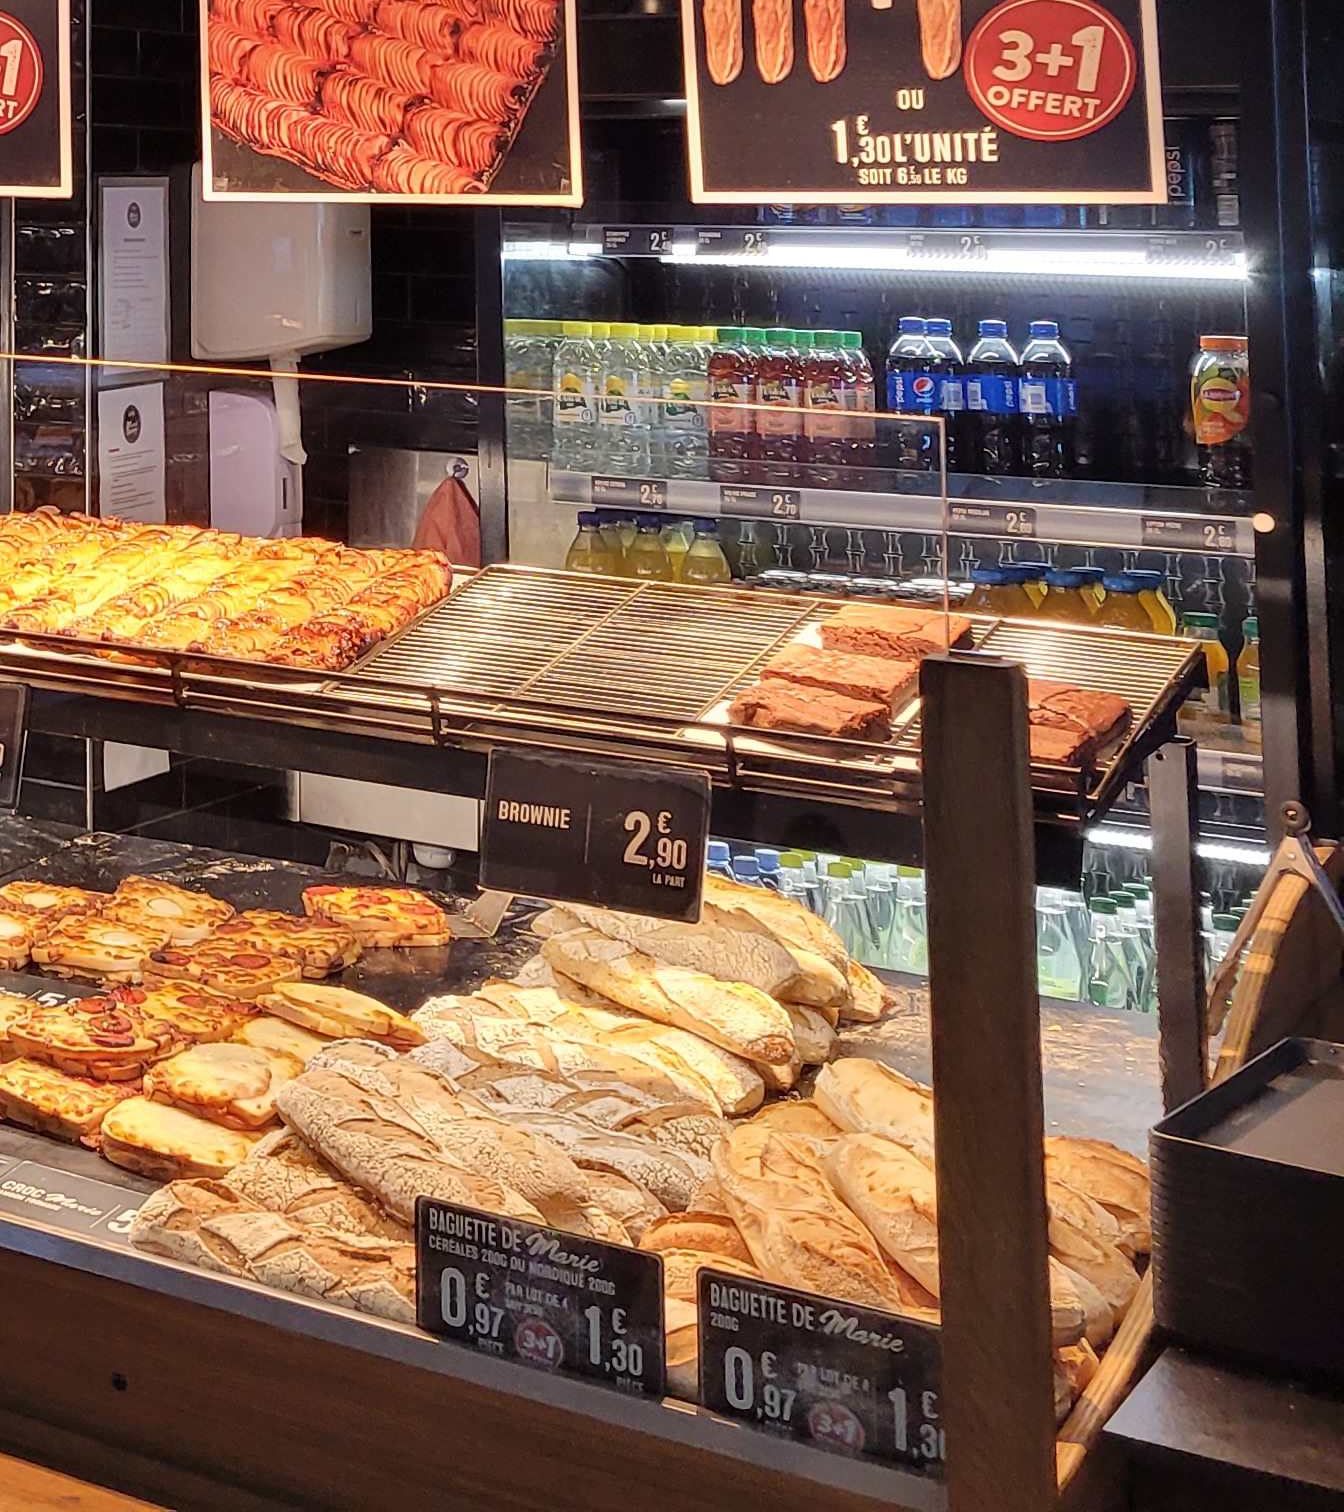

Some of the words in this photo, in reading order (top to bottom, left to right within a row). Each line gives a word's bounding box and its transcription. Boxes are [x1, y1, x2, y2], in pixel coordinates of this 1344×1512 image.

[992, 26, 1105, 92] 3+1
[896, 89, 924, 110] OU
[987, 85, 1101, 120] OFFERT
[858, 169, 892, 185] SOIT
[924, 168, 941, 184] LE
[945, 168, 968, 184] KG
[1165, 146, 1186, 196] pepsi
[498, 800, 571, 829] BROWNIE
[652, 873, 662, 884] LA
[665, 874, 686, 888] PART
[1, 1180, 46, 1198] CROC
[45, 1192, 103, 1216] Marie
[429, 1207, 496, 1246] BAGUETTE
[501, 1226, 523, 1252] DE
[525, 1232, 600, 1273] Marie
[429, 1233, 479, 1260] CÉRÉALES
[481, 1249, 507, 1268] 200G
[510, 1256, 525, 1273] OU
[529, 1260, 584, 1288] NORDIQUE
[710, 1282, 788, 1324] BAGUETTE
[792, 1302, 815, 1330] DE
[819, 1310, 905, 1353] Marie
[710, 1312, 739, 1332] 200G
